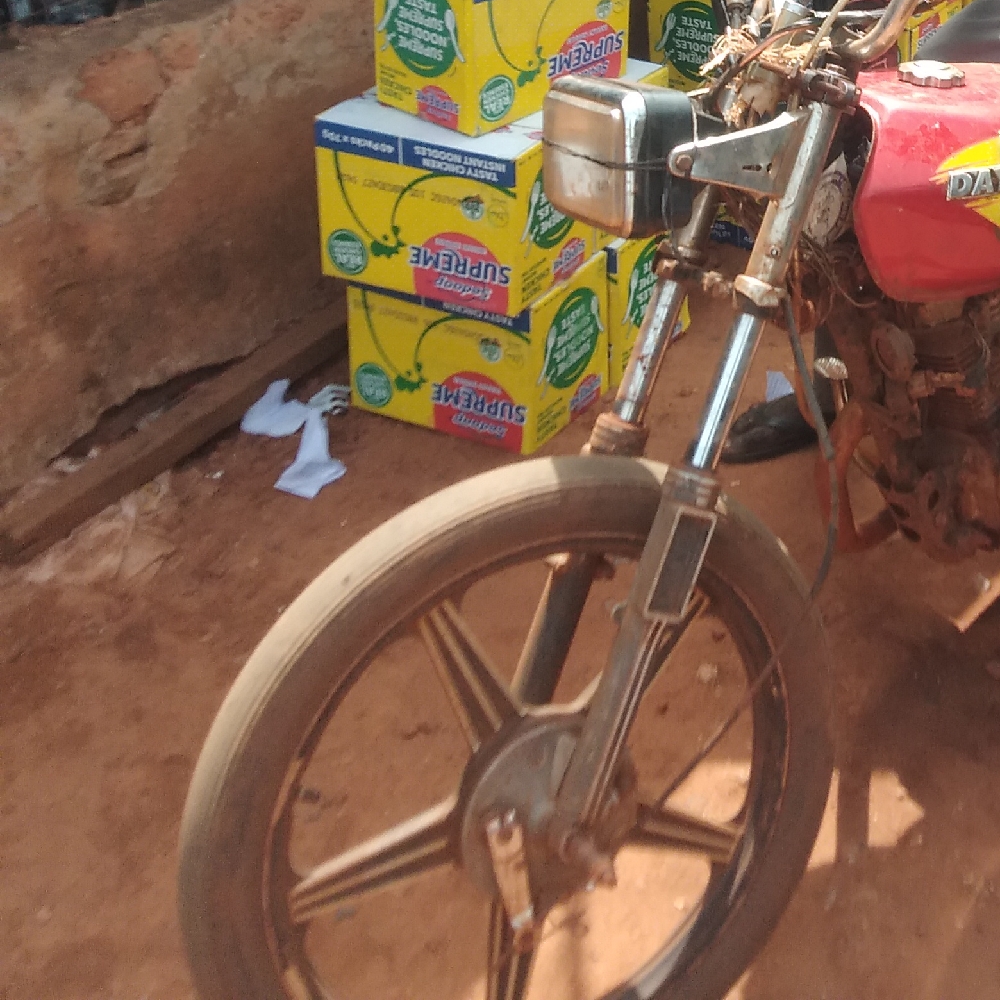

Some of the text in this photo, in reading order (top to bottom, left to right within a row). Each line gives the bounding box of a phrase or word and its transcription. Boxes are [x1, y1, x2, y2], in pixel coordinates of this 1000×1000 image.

[399, 5, 445, 32] SUPREME
[682, 16, 712, 30] TASTE
[397, 34, 444, 63] SUPREME
[547, 30, 624, 78] SUPREME
[422, 158, 499, 182] TASTY CHICKEN
[463, 155, 507, 173] INSTANT
[407, 246, 513, 286] SUPREME
[432, 382, 528, 425] SUPREME
